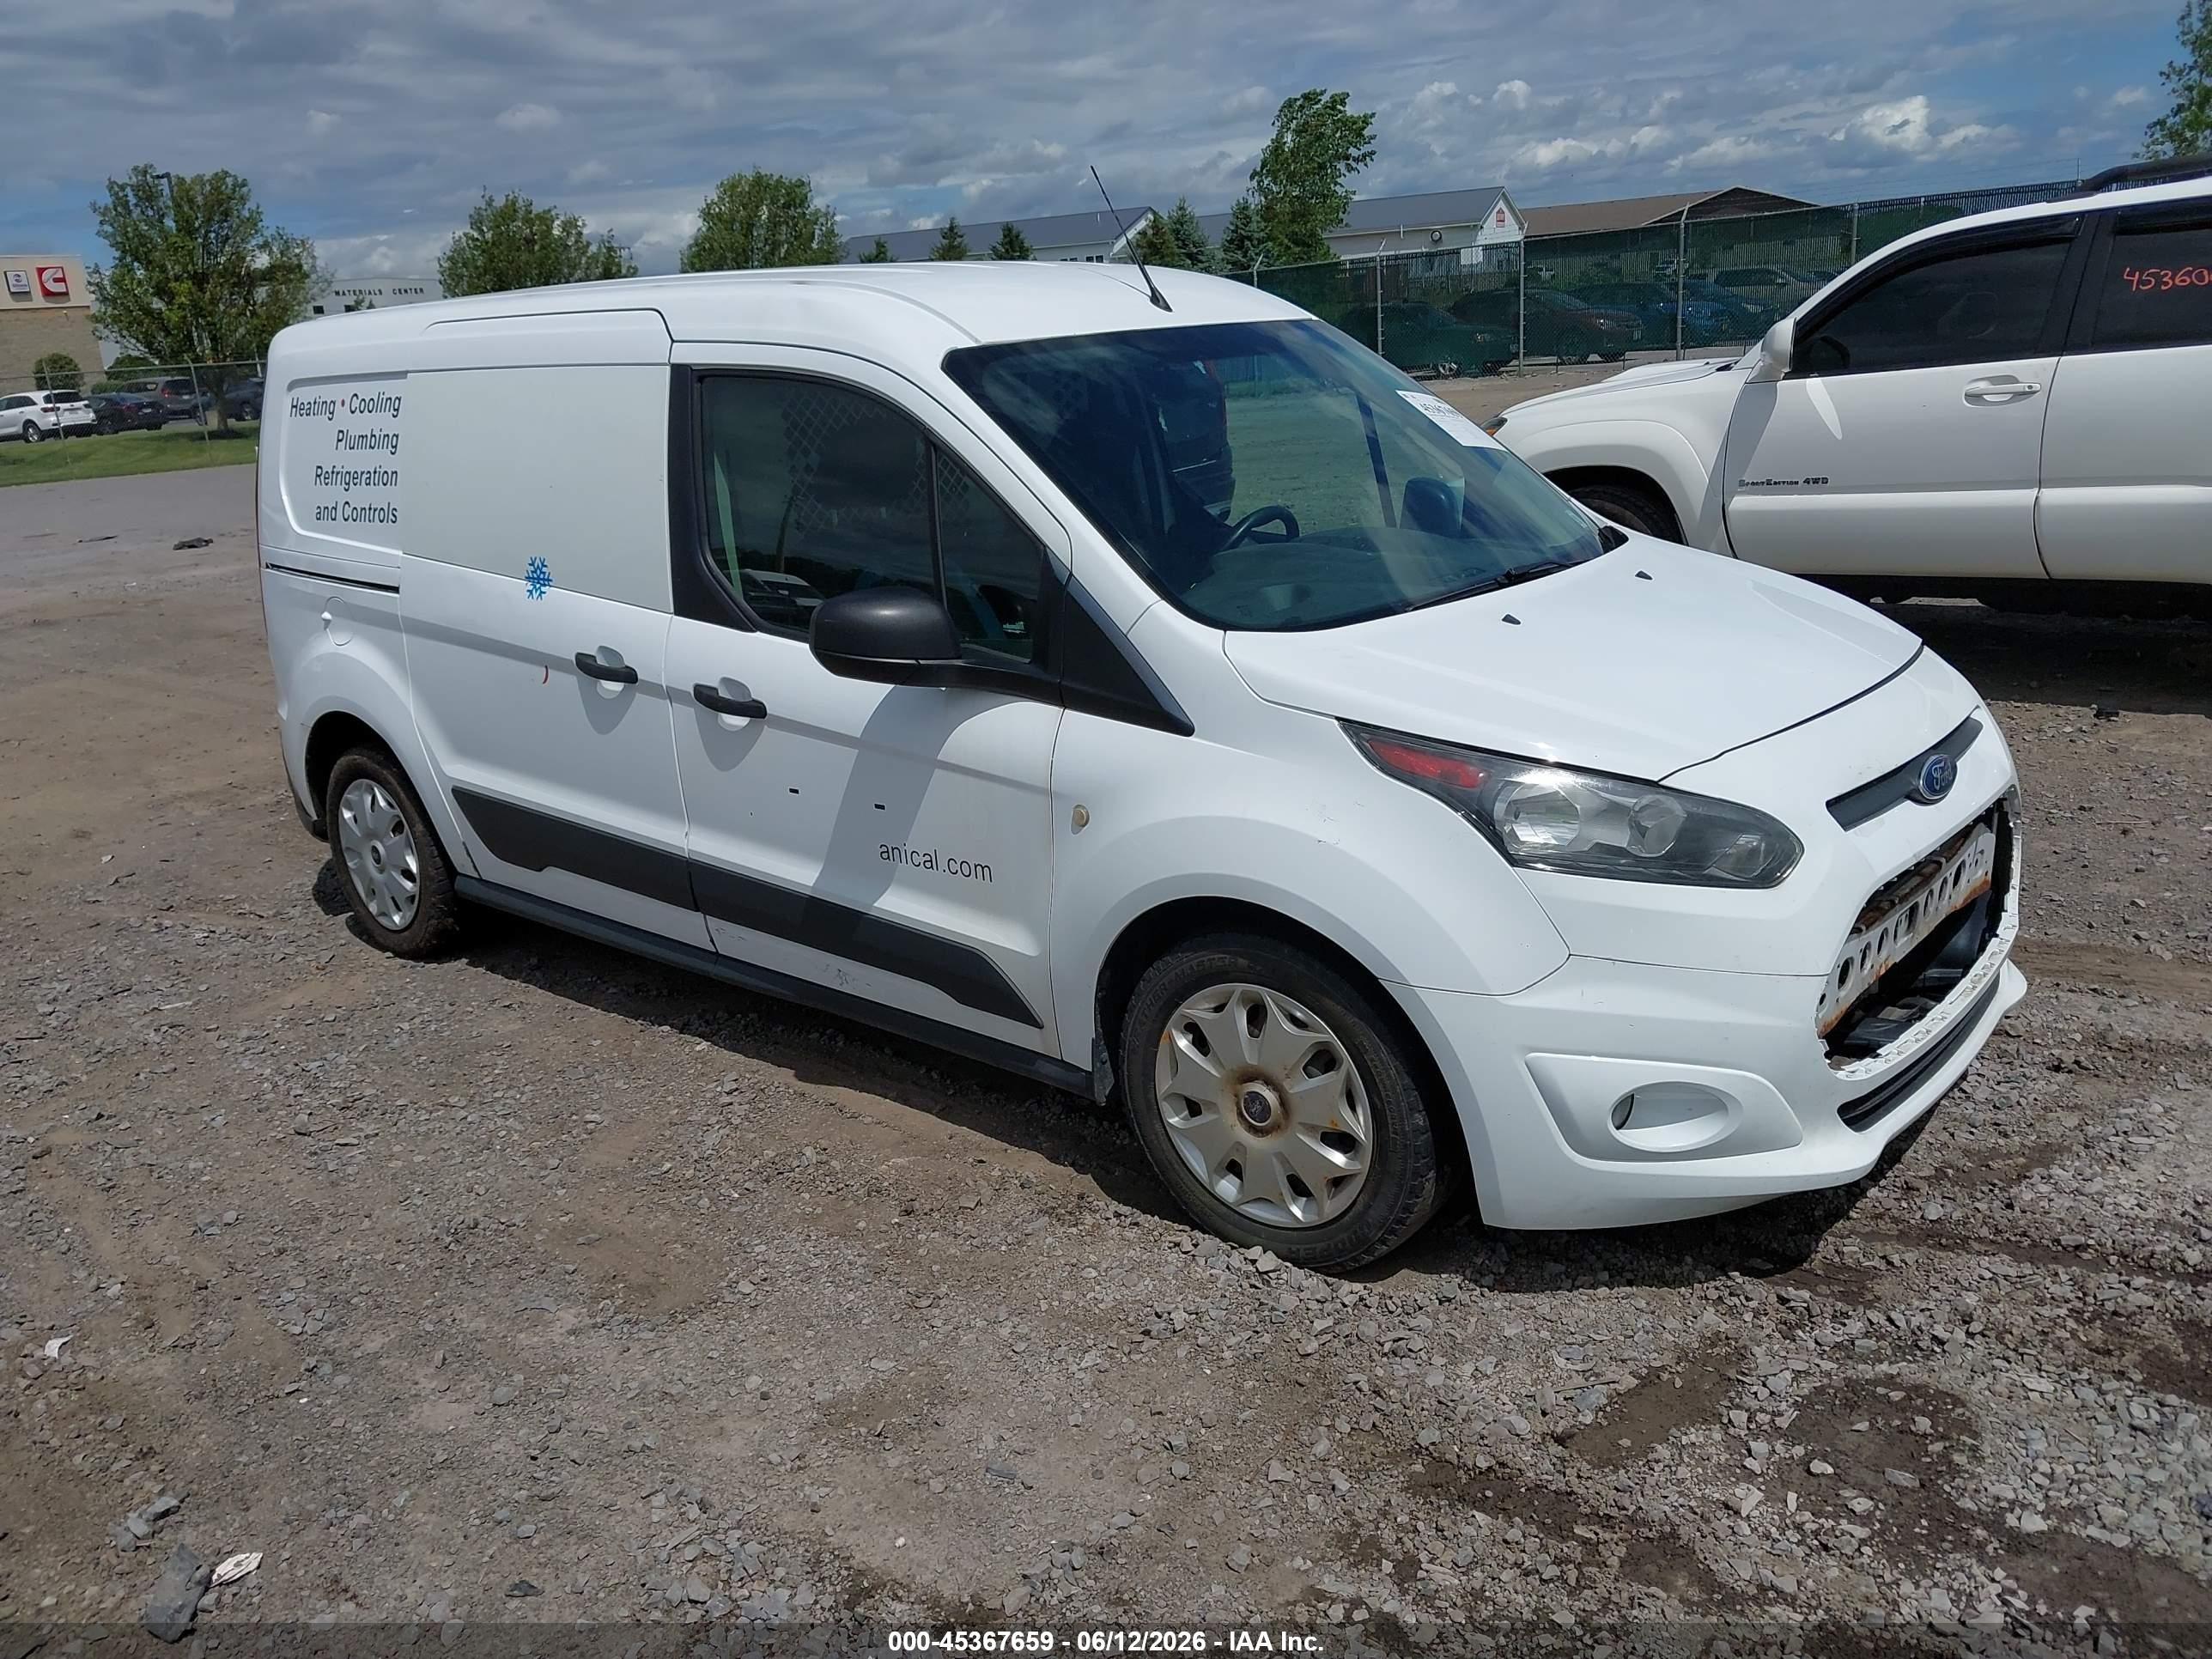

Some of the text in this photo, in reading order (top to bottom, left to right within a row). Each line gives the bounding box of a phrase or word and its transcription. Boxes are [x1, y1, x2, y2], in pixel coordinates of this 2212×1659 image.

[2124, 267, 2212, 291] 45360
[289, 396, 336, 422] Heating
[349, 392, 401, 418] Cooling
[335, 428, 399, 455] Plumbing
[314, 465, 398, 492] Refrigeration
[1803, 477, 1829, 485] 4WD
[315, 501, 398, 524] and Controls
[879, 842, 993, 883] anical.com
